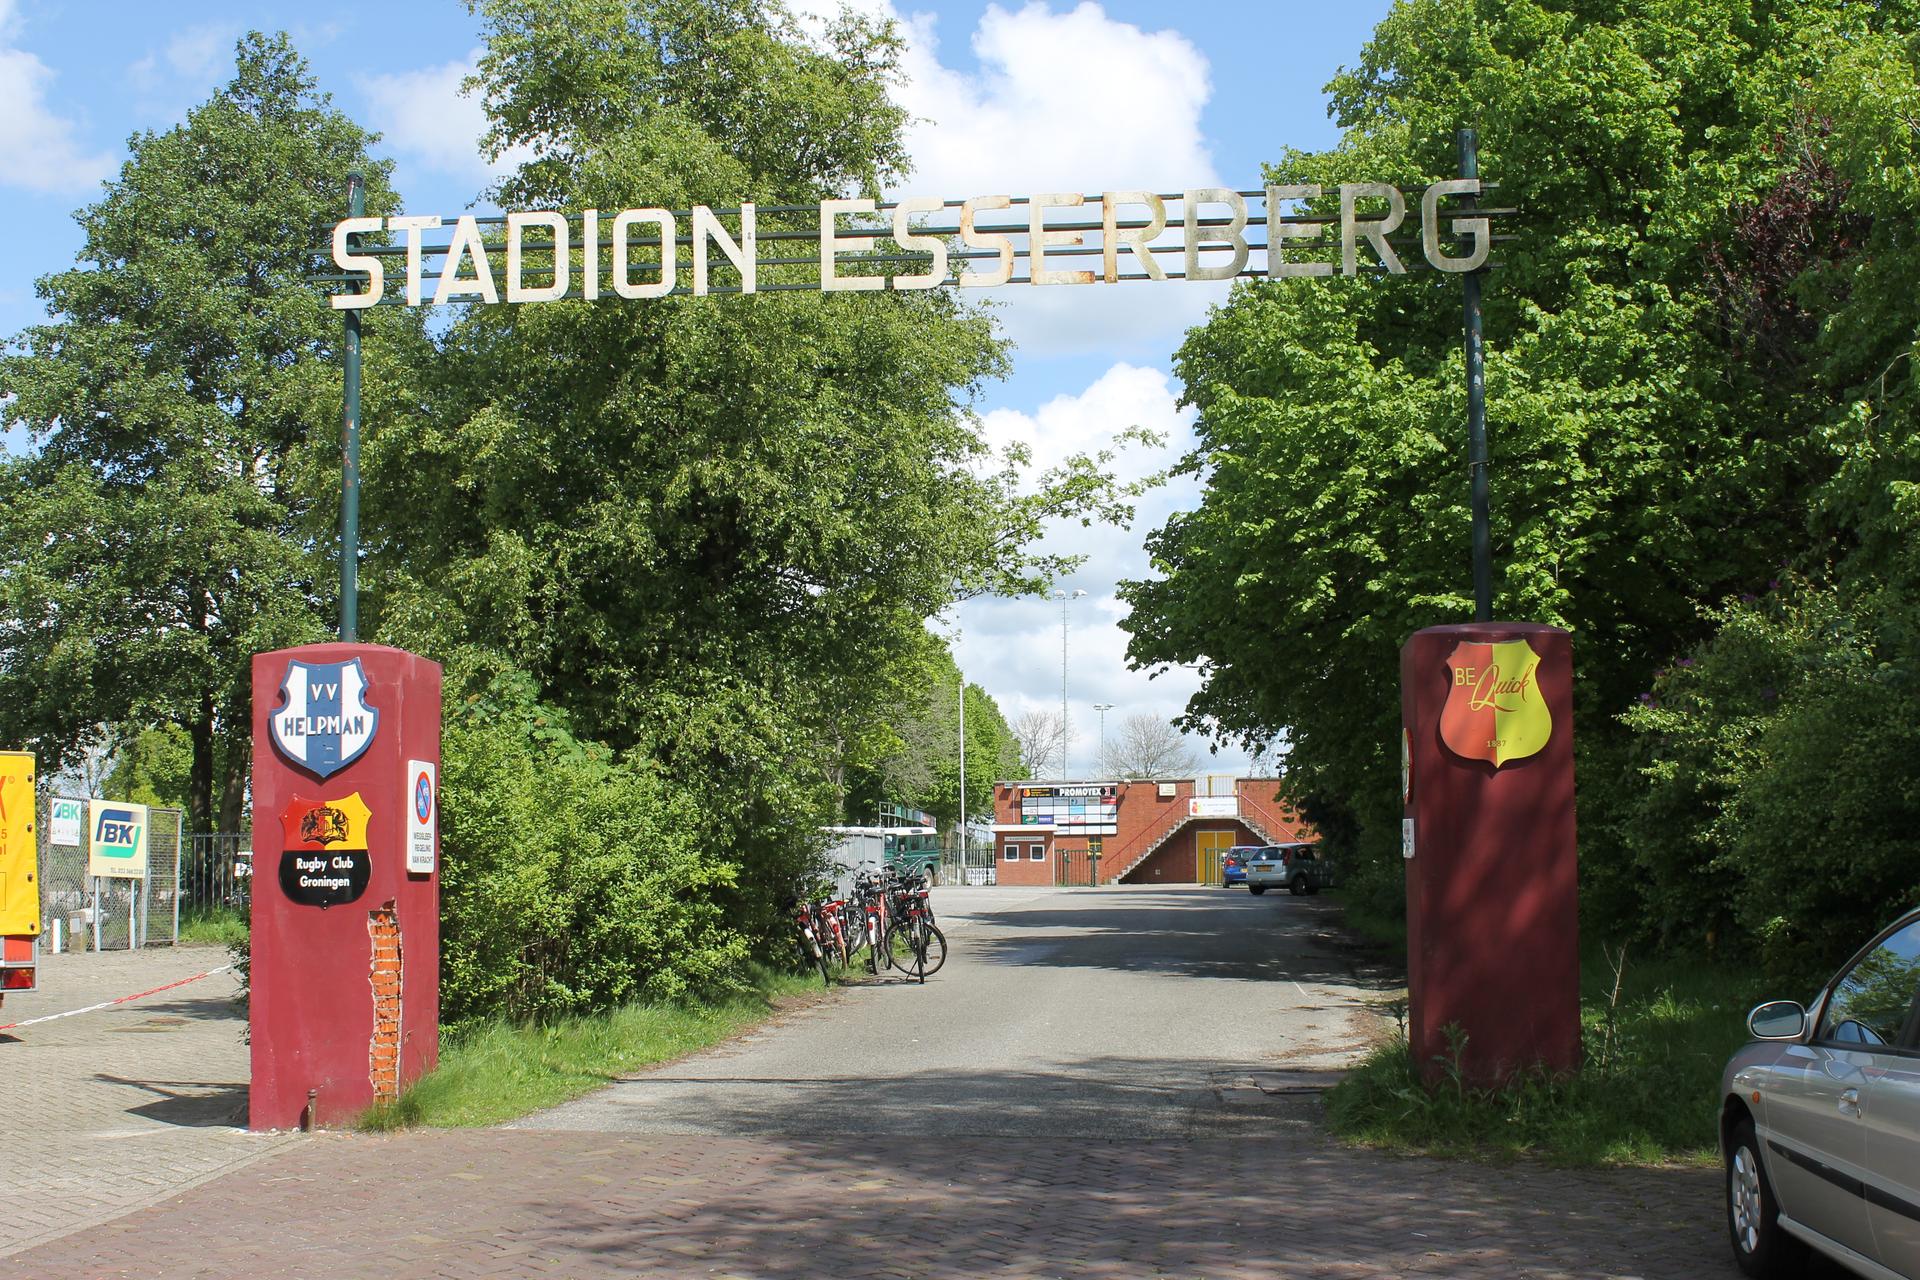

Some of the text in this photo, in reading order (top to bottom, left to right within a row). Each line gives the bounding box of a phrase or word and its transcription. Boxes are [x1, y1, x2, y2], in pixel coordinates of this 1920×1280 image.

[332, 179, 1490, 310] STADION ESSERBERG
[1455, 663, 1533, 713] BE Quick
[284, 715, 364, 736] HELPMAN
[1060, 787, 1102, 797] PROMOTEX
[296, 856, 354, 873] Rugby Club
[300, 875, 350, 890] Groningen
